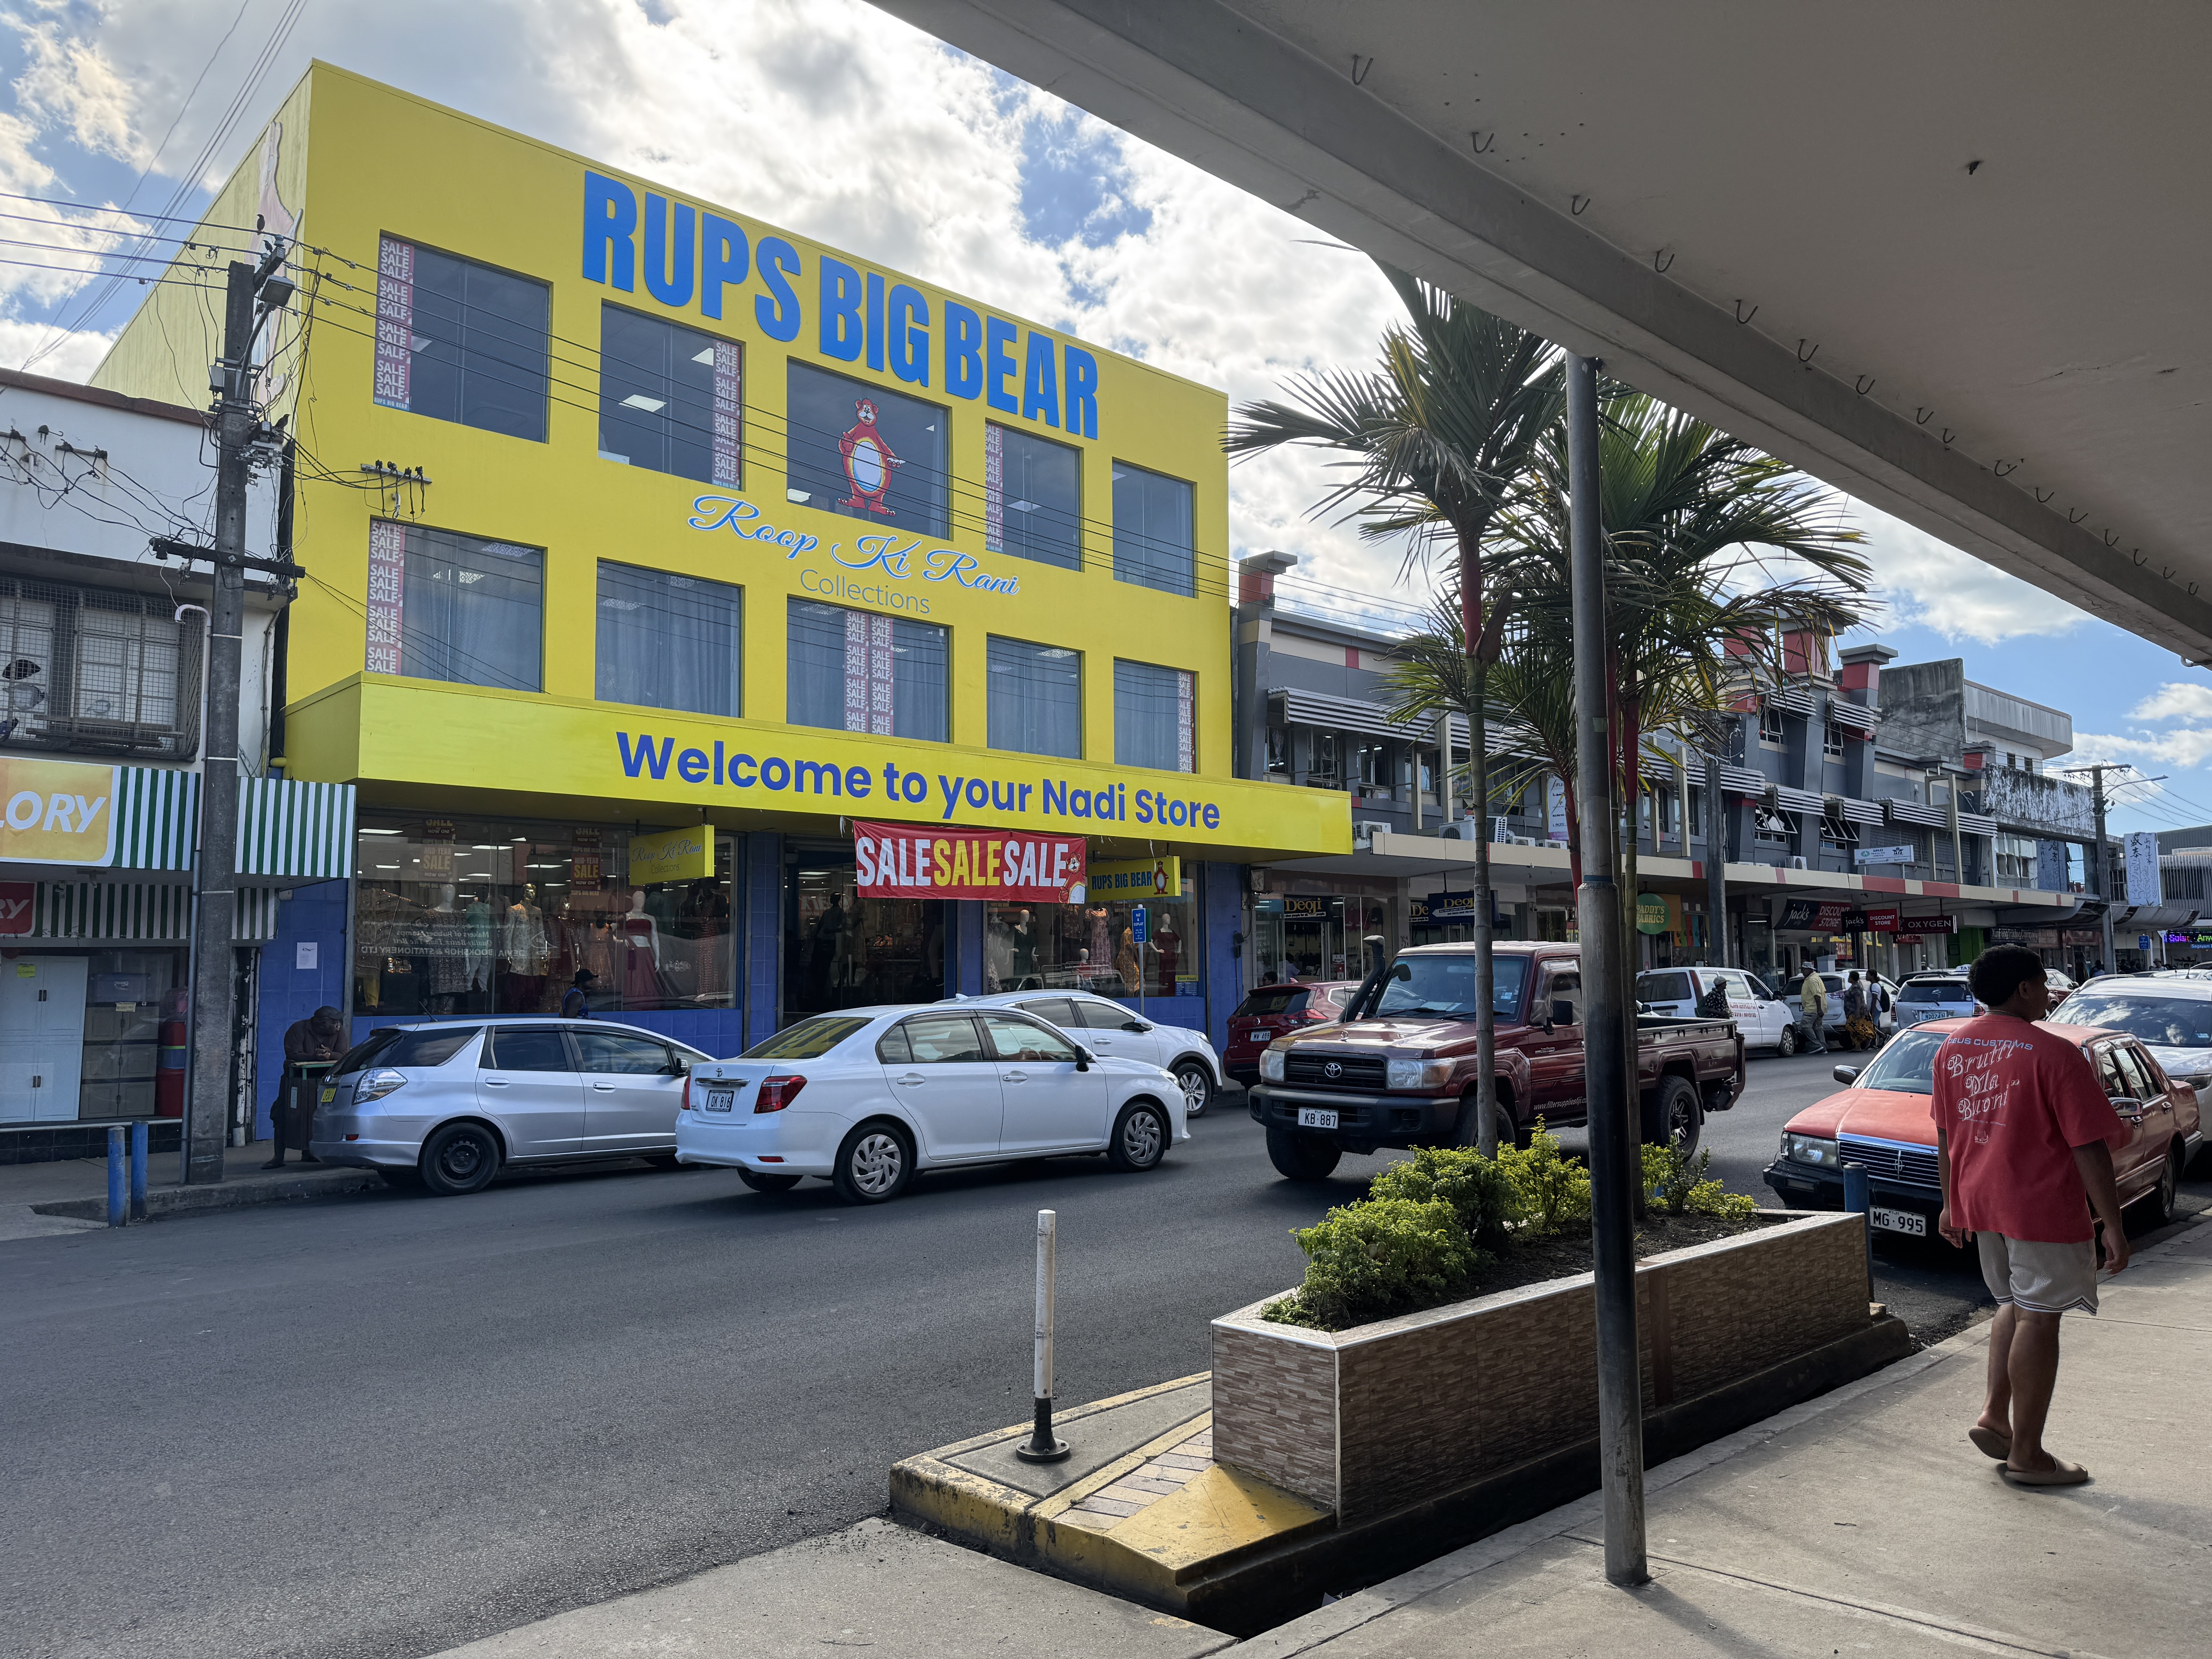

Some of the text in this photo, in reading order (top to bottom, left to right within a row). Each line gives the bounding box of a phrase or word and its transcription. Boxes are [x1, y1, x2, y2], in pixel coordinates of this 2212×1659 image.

[381, 240, 409, 258] SALE
[381, 252, 409, 269] SALE
[380, 280, 407, 298] SALE
[380, 303, 406, 320] SALE
[583, 170, 1097, 440] RUPS BIG BEAR
[379, 320, 407, 337] SALE
[716, 342, 737, 357] SALE
[716, 352, 737, 368] SALE
[716, 362, 737, 377] SALE
[716, 377, 737, 392] SALE
[716, 397, 736, 412] SALE
[371, 535, 400, 550] SALE
[687, 494, 1020, 596] Roop Ki Rani
[371, 547, 399, 563] SALE
[370, 565, 398, 579] SALE
[370, 577, 398, 591] SALE
[800, 568, 930, 614] Collections
[369, 589, 398, 603] SALE
[847, 612, 866, 624] SALE
[872, 617, 890, 628] SALE
[847, 622, 866, 634] SALE
[872, 627, 890, 638] SALE
[847, 632, 866, 643] SALE
[872, 637, 890, 647] SALE
[847, 646, 866, 656] SALE
[872, 650, 890, 660] SALE
[847, 655, 866, 666] SALE
[872, 659, 890, 670] SALE
[1179, 673, 1190, 682] SALE
[1179, 681, 1190, 690] SALE
[1179, 709, 1191, 717] SALE
[1179, 716, 1191, 725] SALE
[616, 732, 1220, 830] Welcome to your Nadi Store
[0, 790, 106, 833] ORY
[632, 839, 702, 864] Roop Ki Rani
[422, 855, 451, 870] SALE
[651, 863, 680, 874] Collections
[857, 837, 1068, 887] SALE SALE SALE
[574, 864, 598, 878] SALE
[1092, 871, 1152, 890] RUPS BIG BEAR
[1784, 903, 1810, 926] jack's
[1819, 905, 1850, 916] DISCOUNT
[1819, 918, 1841, 927] STORE
[1845, 916, 1864, 928] jack's
[1908, 920, 1951, 928] OXYGEN
[2021, 929, 2038, 941] Company
[1973, 1039, 2033, 1050] CUSTOMS
[720, 1096, 731, 1108] 816
[1305, 1112, 1336, 1127] KB 887
[1873, 1211, 1923, 1233] MG 995
